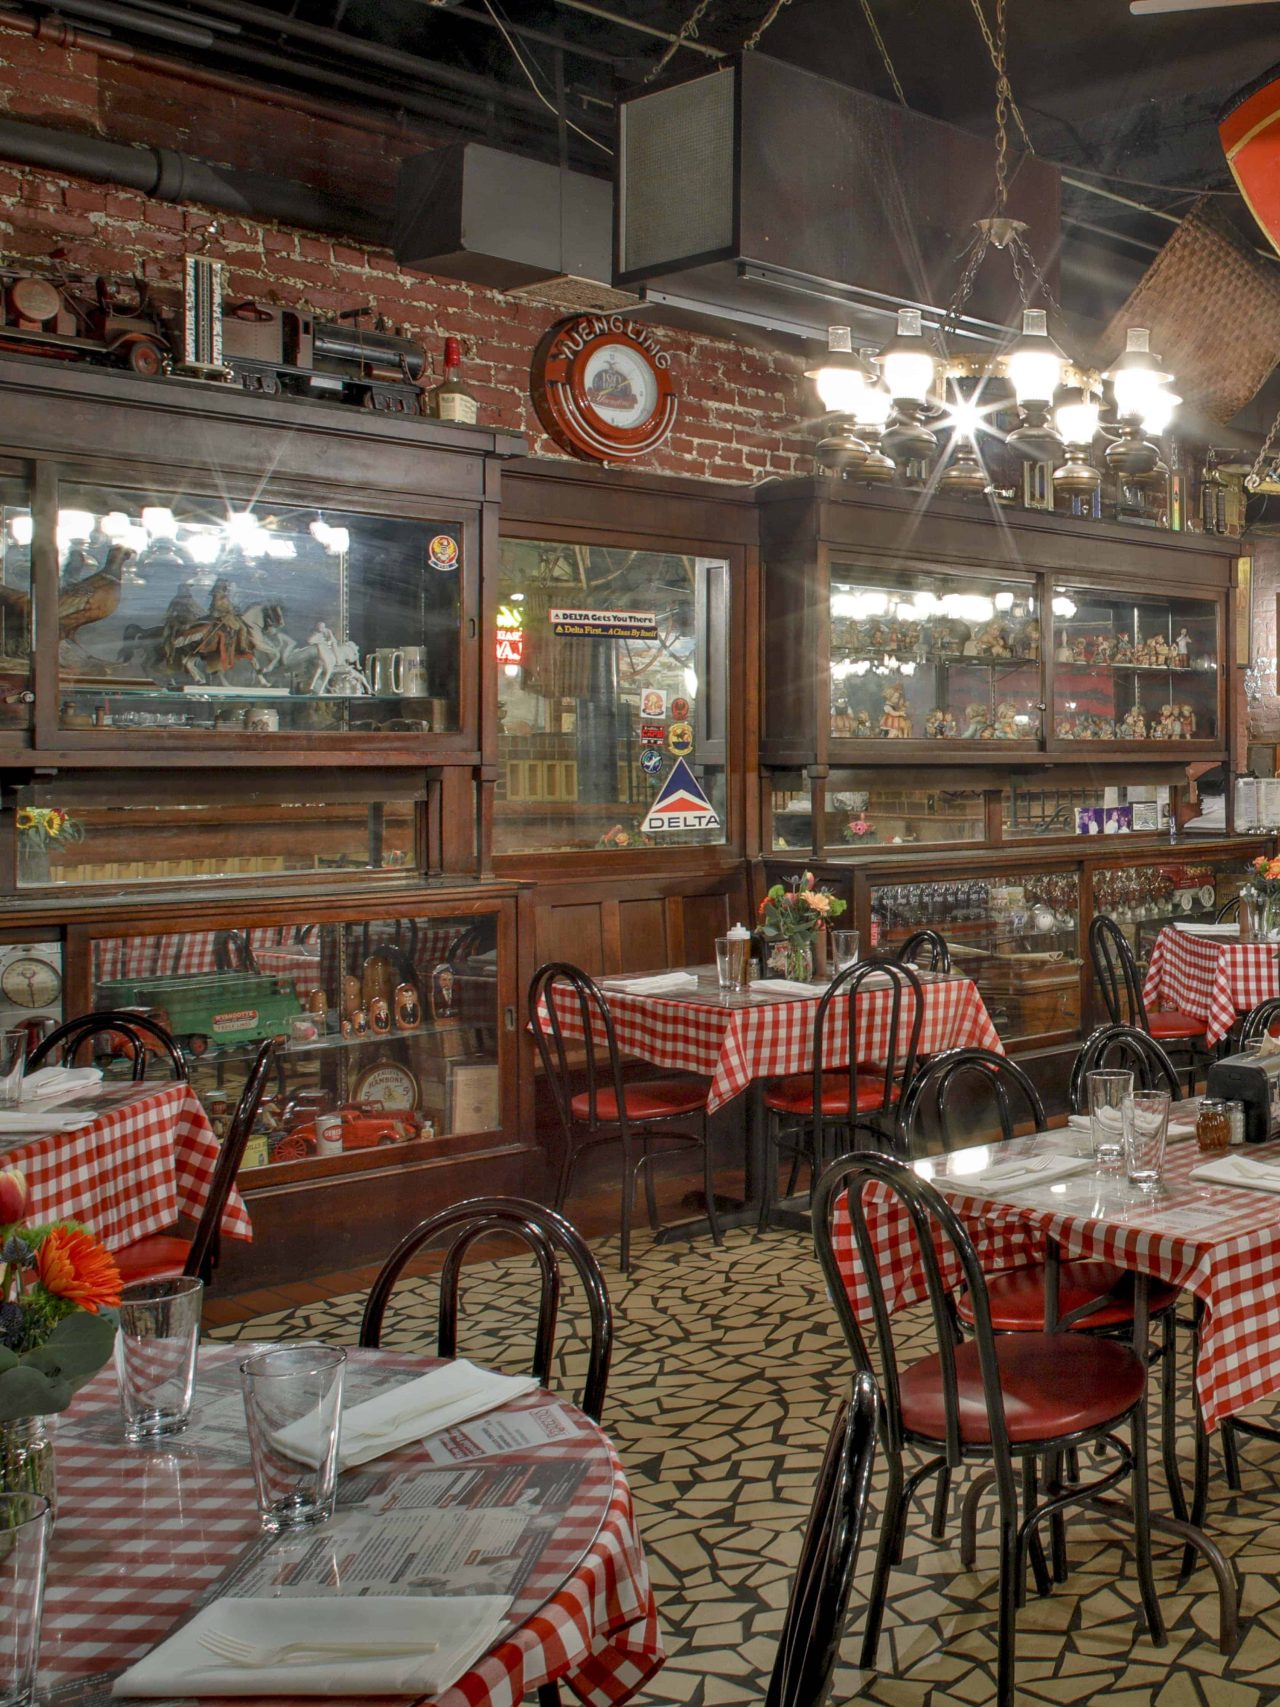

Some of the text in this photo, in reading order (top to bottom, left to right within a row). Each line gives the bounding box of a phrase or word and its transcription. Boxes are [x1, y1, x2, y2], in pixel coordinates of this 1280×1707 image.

[558, 314, 671, 369] YUENGLING
[562, 613, 654, 624] DELTA Gets You There
[564, 625, 584, 634] Delta
[649, 815, 720, 830] DELTA
